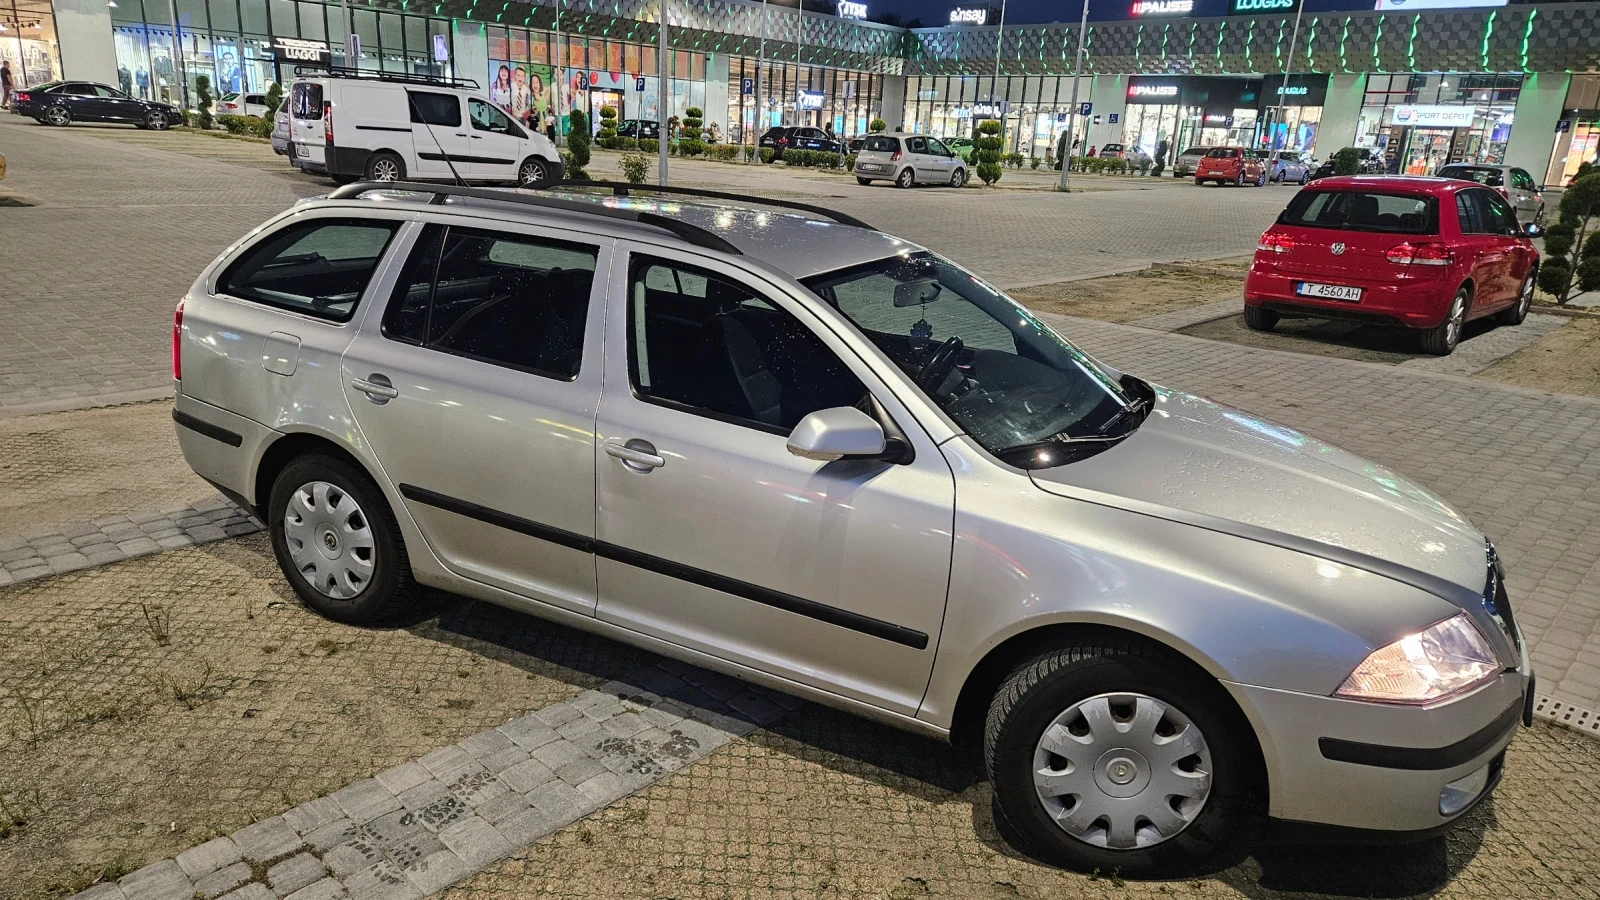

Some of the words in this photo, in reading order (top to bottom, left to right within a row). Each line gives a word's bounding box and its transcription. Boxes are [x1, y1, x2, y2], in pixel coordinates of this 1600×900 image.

[844, 1, 867, 17] JYSK
[951, 7, 986, 25] sinsay
[1277, 86, 1308, 95] DUGLAS
[1307, 284, 1314, 294] T
[1318, 285, 1344, 297] 4560
[1344, 288, 1360, 299] AH
